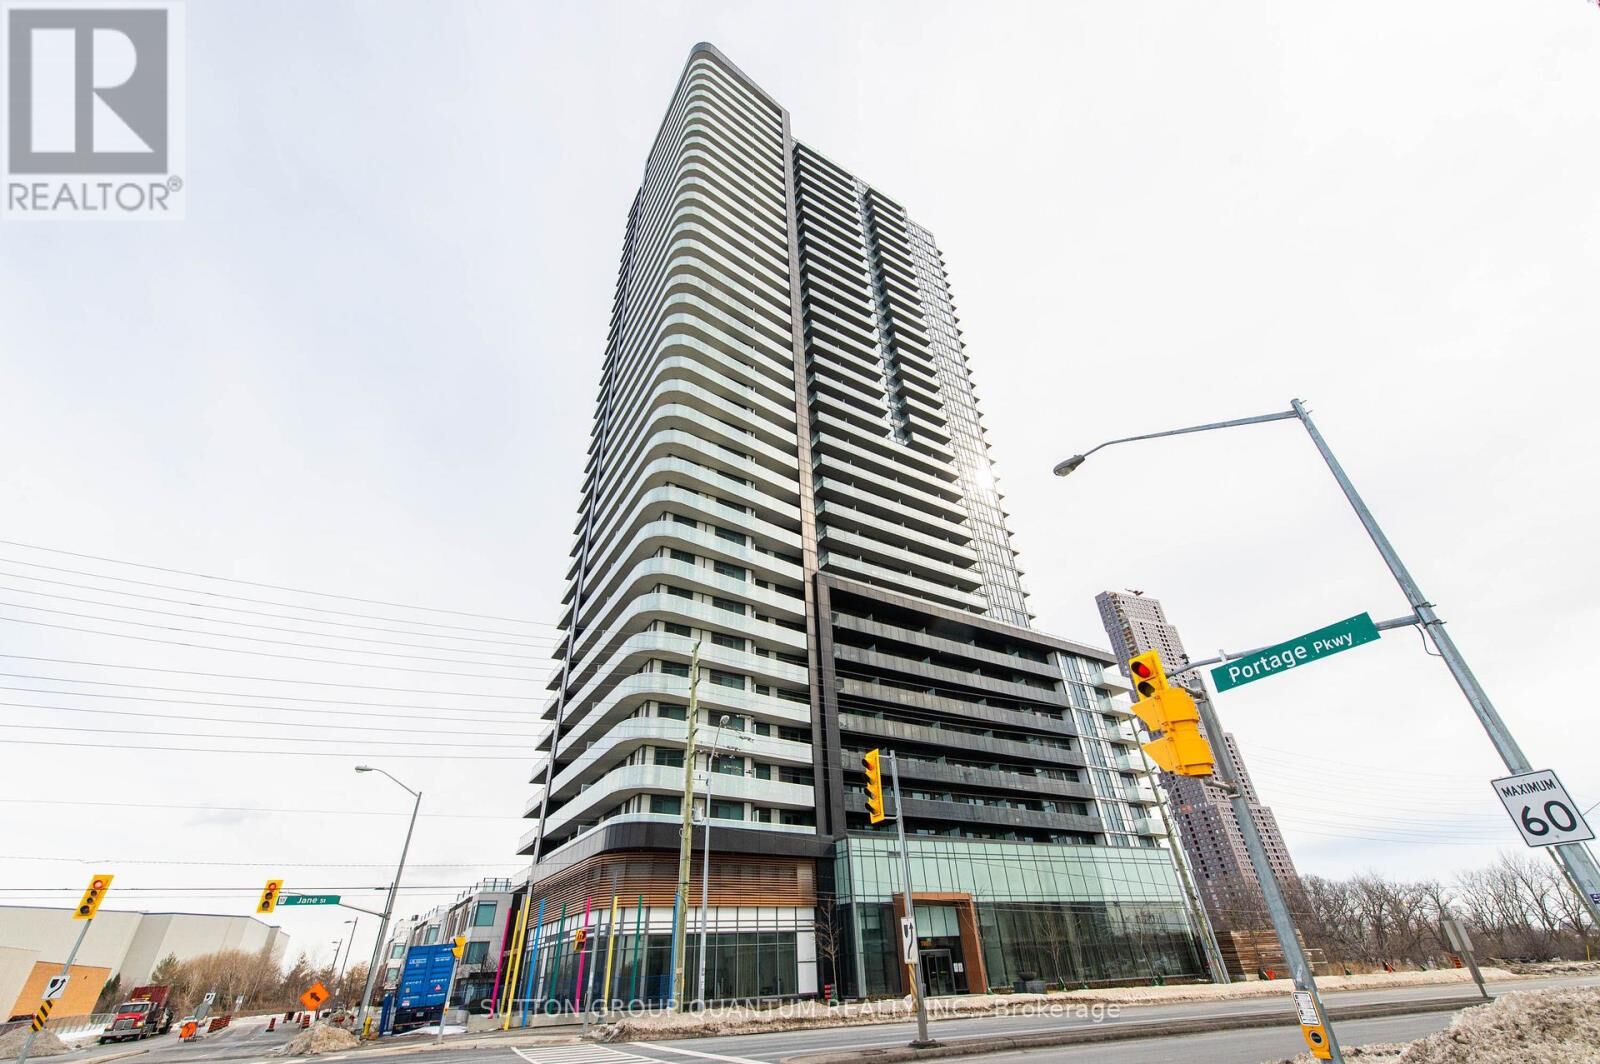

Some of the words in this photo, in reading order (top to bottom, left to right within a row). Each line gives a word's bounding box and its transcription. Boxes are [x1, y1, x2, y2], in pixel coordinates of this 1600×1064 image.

[1228, 646, 1308, 682] Portage
[1312, 632, 1353, 654] Pkwy
[1501, 779, 1557, 798] MAXIMUM
[1521, 800, 1577, 836] 60
[296, 896, 318, 905] Jane
